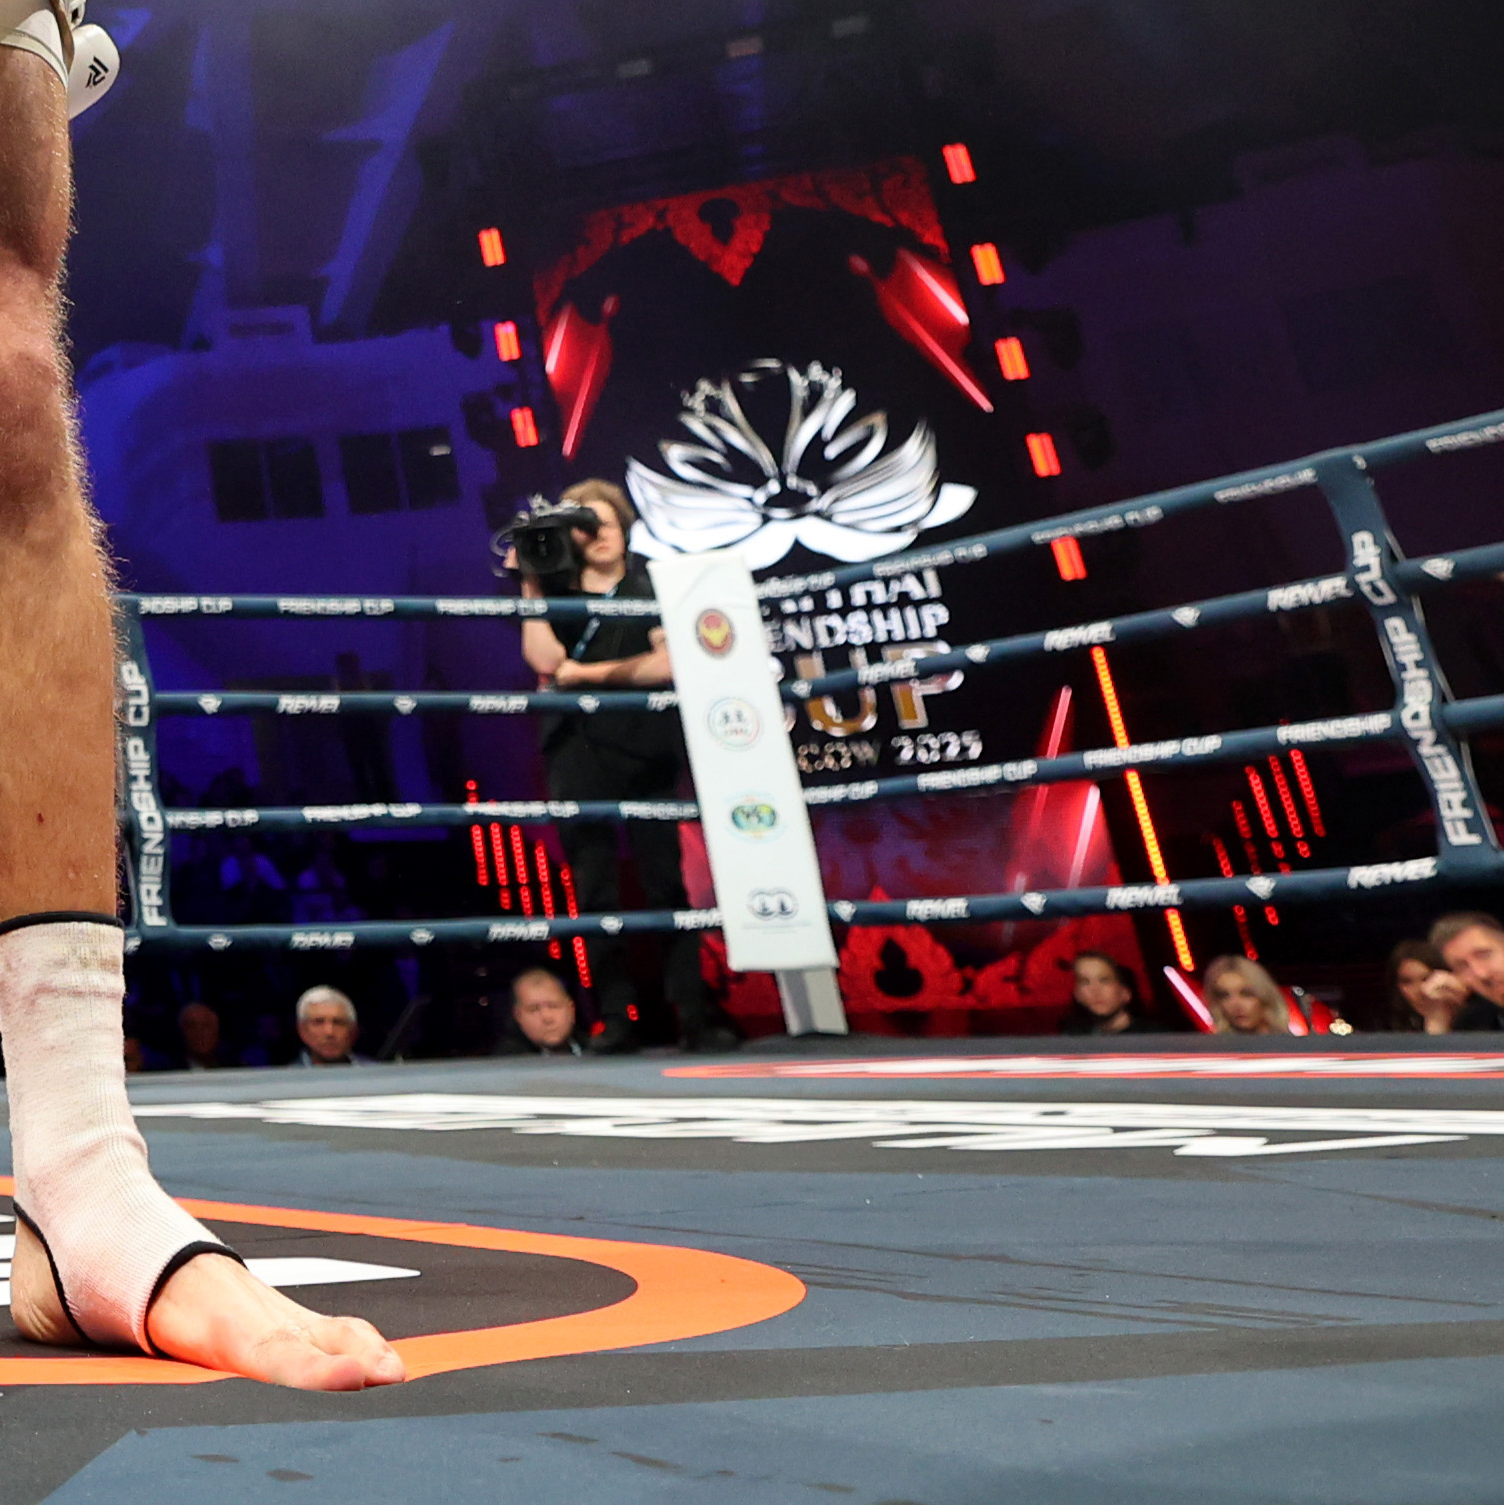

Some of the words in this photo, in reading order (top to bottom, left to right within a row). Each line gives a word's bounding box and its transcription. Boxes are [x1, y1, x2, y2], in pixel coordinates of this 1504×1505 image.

[1351, 530, 1397, 606] CUP
[763, 602, 950, 652] ENDSHIP
[120, 660, 150, 727] CUP
[1384, 615, 1483, 846] FRIENDSHIP
[126, 736, 168, 926] FRIENDSHIP
